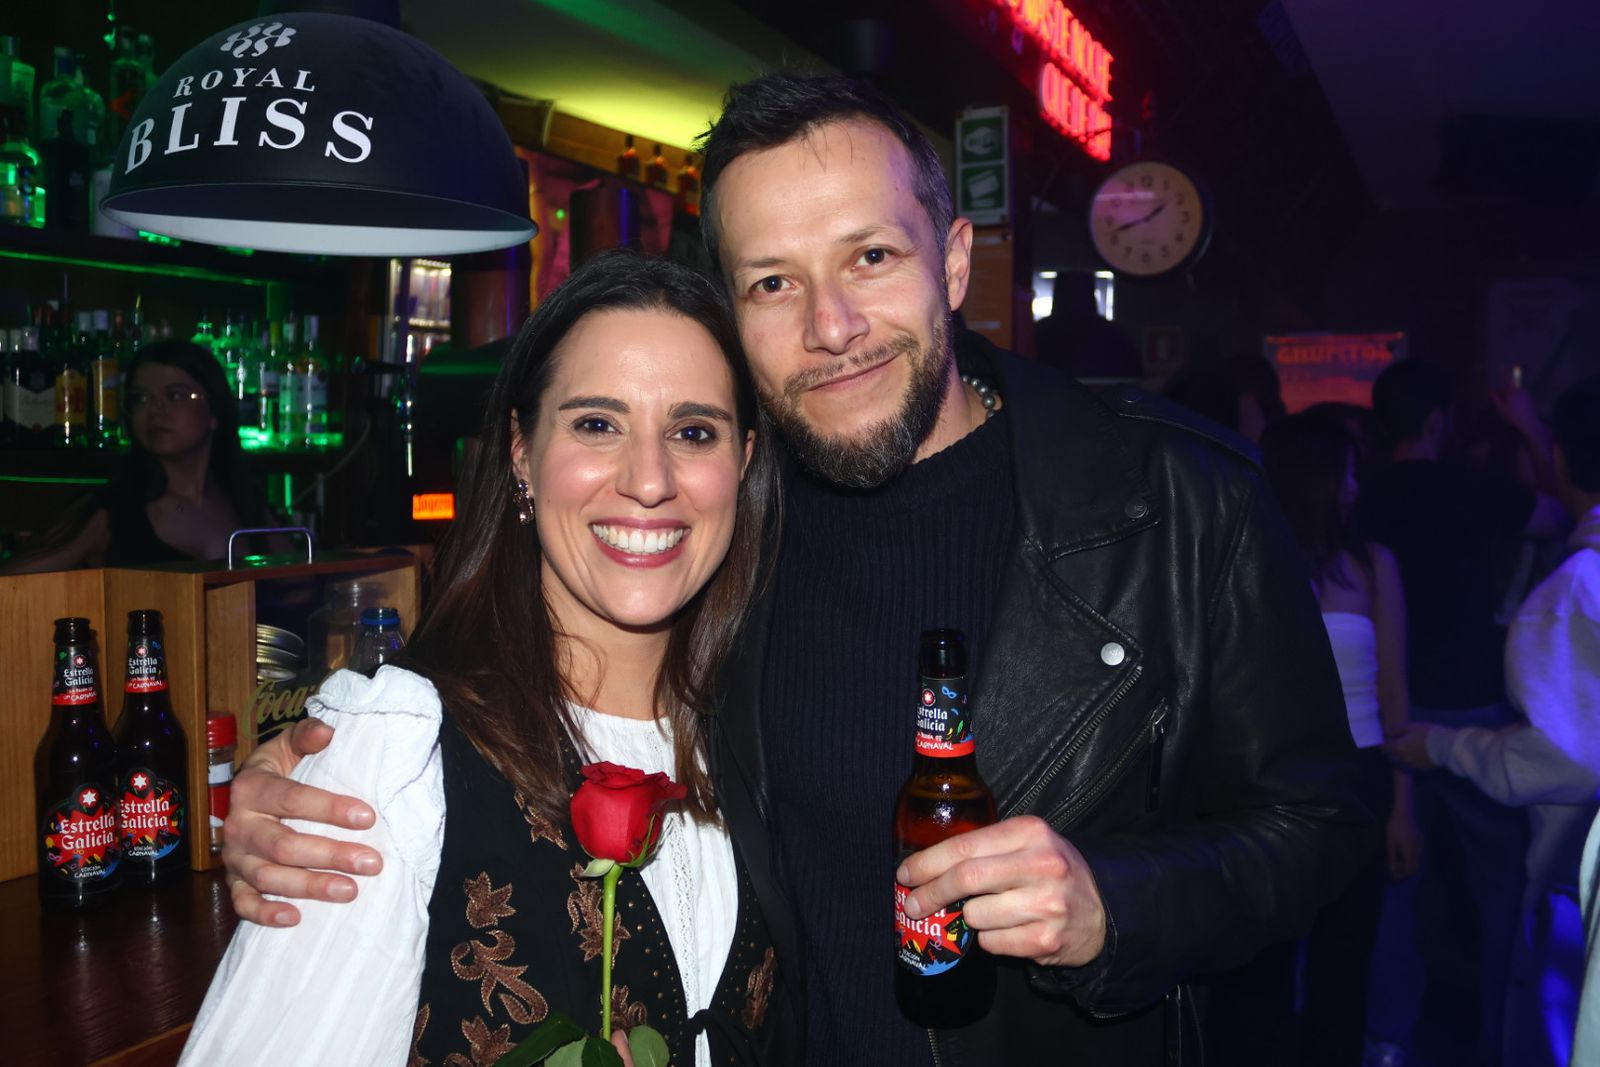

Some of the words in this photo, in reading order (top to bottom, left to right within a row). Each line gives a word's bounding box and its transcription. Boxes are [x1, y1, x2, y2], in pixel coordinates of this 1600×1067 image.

[173, 67, 315, 98] ROYAL
[124, 96, 375, 176] BLISS
[129, 657, 157, 666] Estrella
[63, 667, 94, 678] Estrella
[129, 666, 157, 675] Galicia
[64, 675, 94, 687] Galicia
[59, 814, 115, 834] Estrella
[61, 830, 113, 850] Galicia
